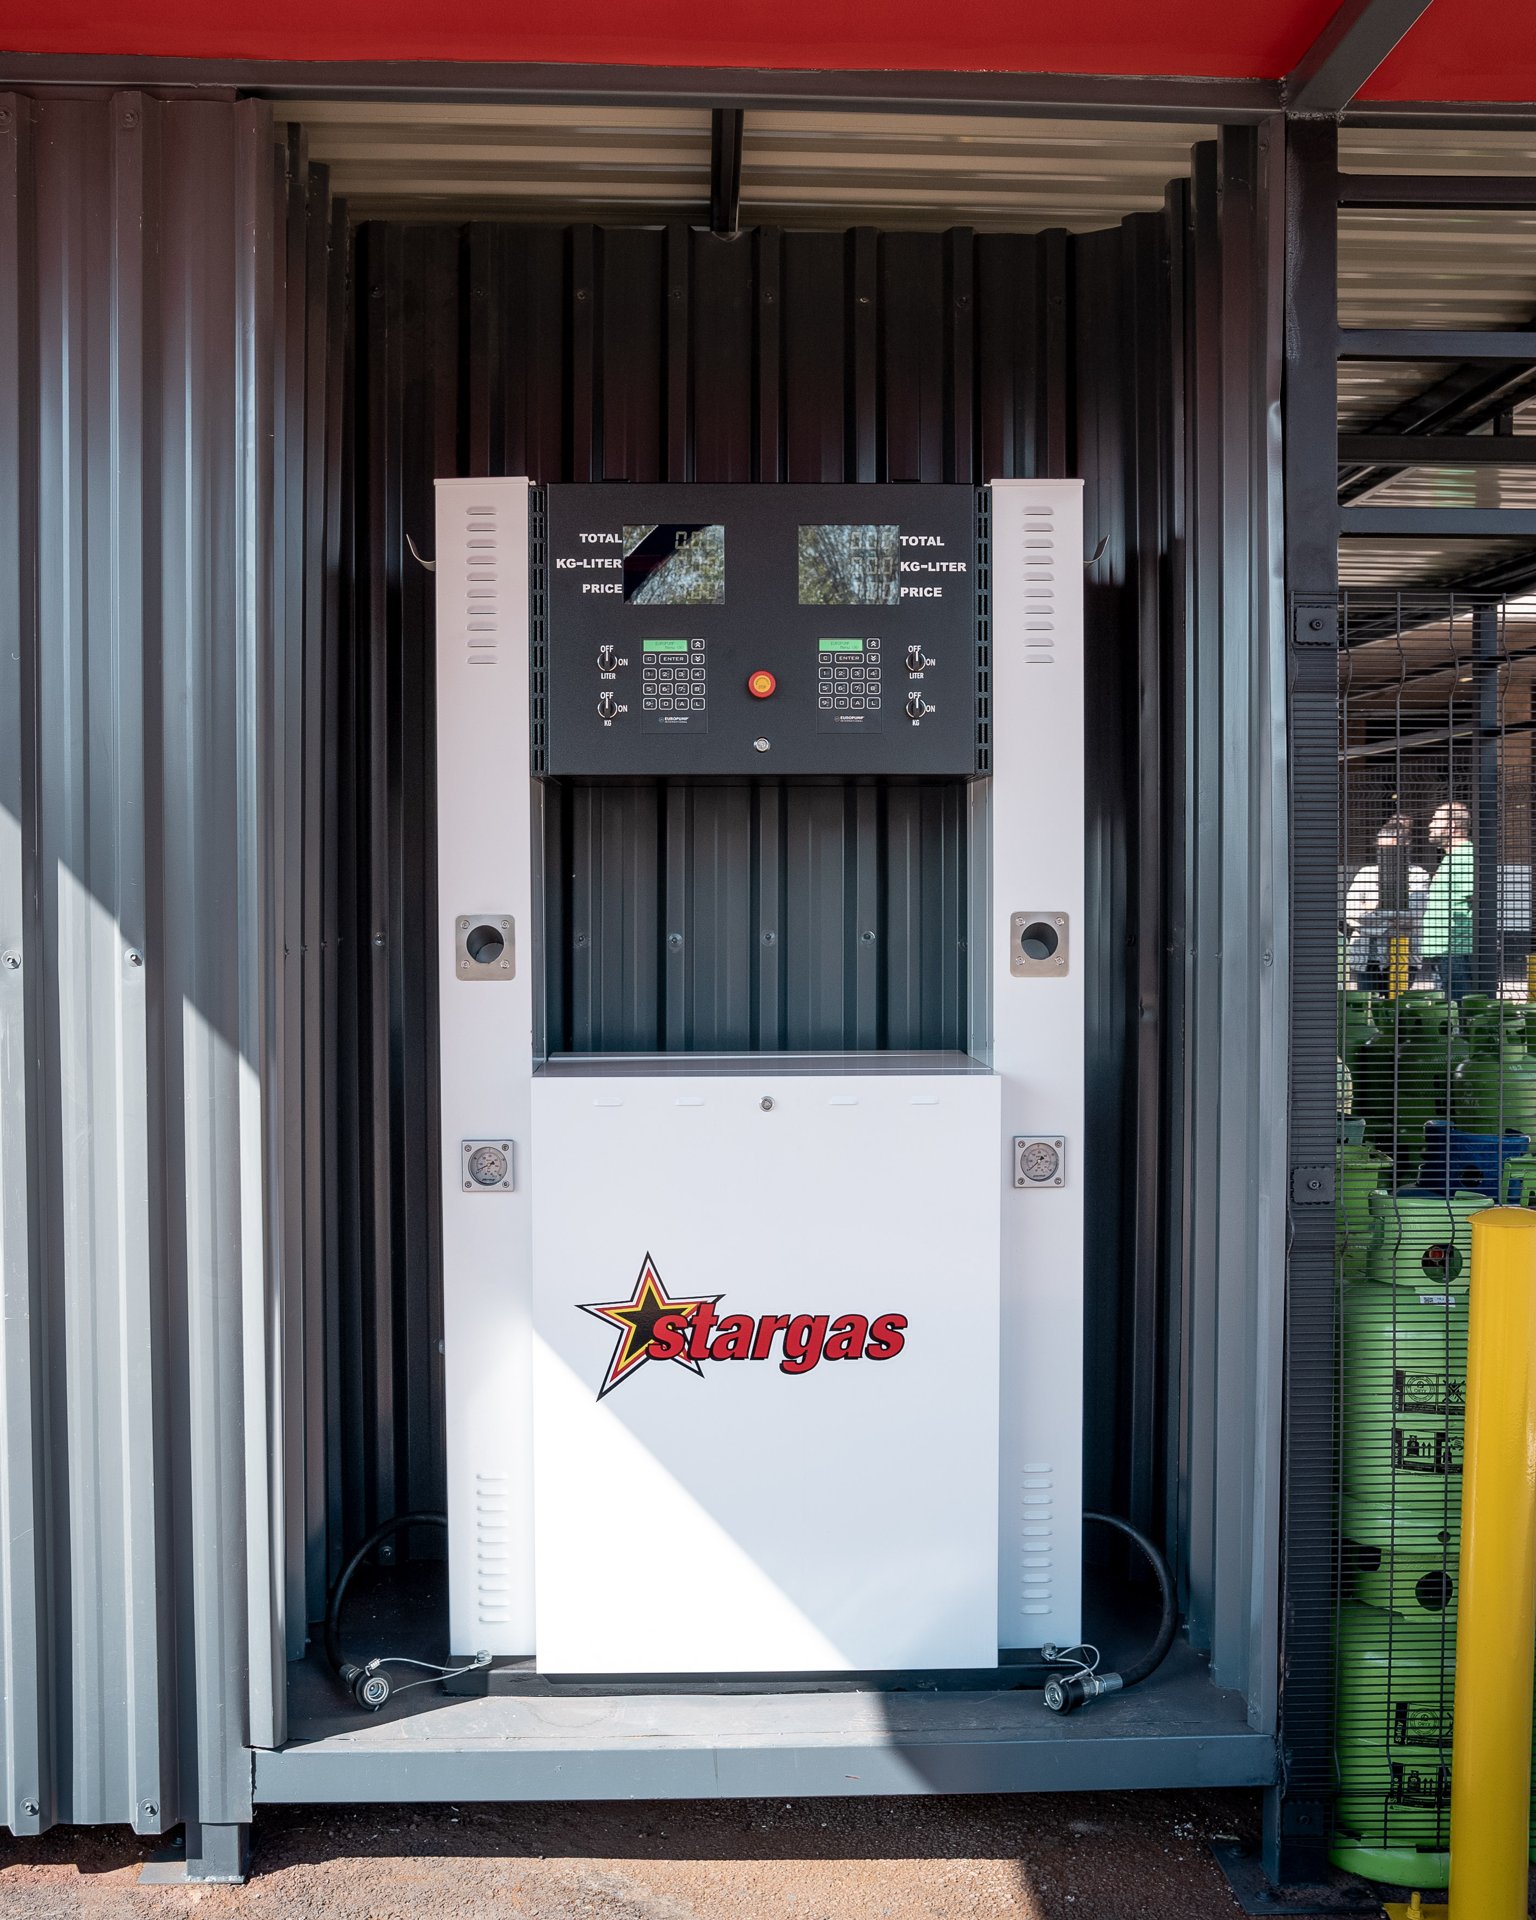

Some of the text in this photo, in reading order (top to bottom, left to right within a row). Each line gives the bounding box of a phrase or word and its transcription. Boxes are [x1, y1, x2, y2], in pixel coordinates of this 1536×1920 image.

[579, 533, 623, 543] TOTAL
[900, 536, 945, 546] TOTAL
[556, 558, 622, 569] KG-LITER
[900, 561, 967, 572] KG-LITER
[582, 584, 623, 593] PRICE
[900, 587, 943, 597] PRICE
[600, 645, 614, 653] OFF
[908, 645, 922, 653] OFF
[646, 1300, 908, 1375] stargas
